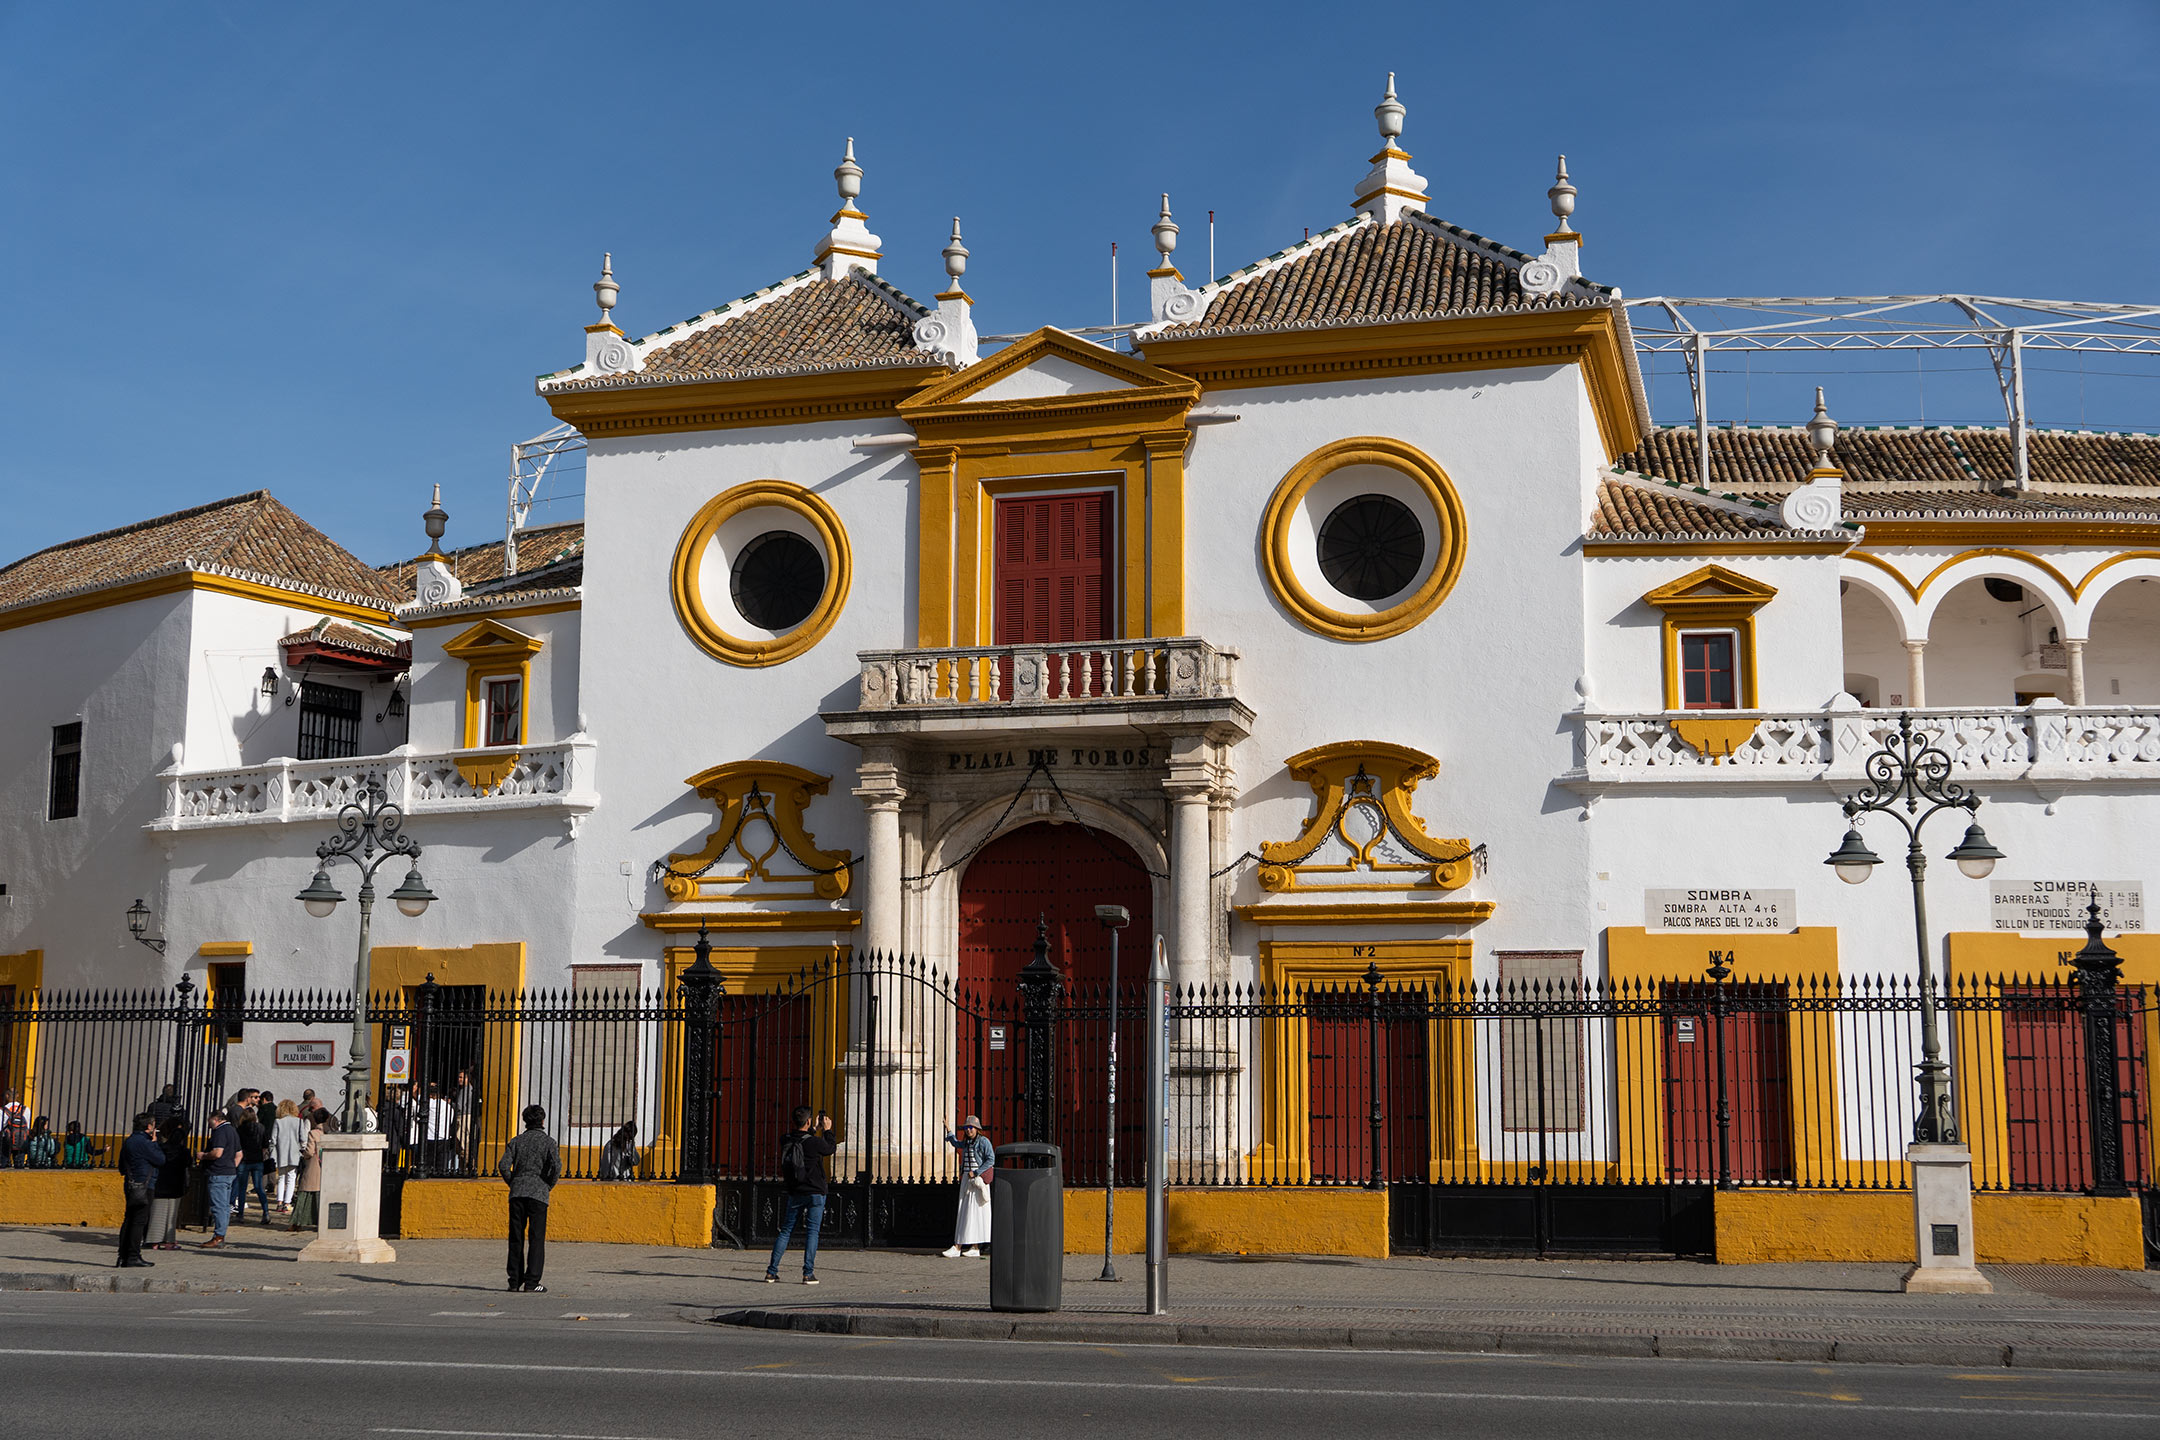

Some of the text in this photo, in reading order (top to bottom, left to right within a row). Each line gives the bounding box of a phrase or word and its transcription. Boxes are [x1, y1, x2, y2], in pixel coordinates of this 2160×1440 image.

[949, 749, 1150, 770] PLAZA DE TOROS
[2033, 881, 2099, 892] SOMBRA
[1687, 890, 1752, 901] SOMBRA
[1994, 894, 2050, 905] BARRERAS
[1664, 904, 1708, 914] SOMBRA
[1718, 904, 1747, 914] ALTA
[1754, 904, 1761, 914] 4
[1771, 904, 1777, 914] 6
[2026, 908, 2071, 918] TENDIDOS
[1663, 916, 1692, 928] PALCOS
[1695, 916, 1722, 928] PARES
[1725, 917, 1741, 928] DEL
[1744, 917, 1754, 928] 12
[1766, 917, 1779, 928] 36
[1995, 919, 2029, 929] SILLON
[2033, 919, 2045, 929] DE
[2106, 919, 2112, 929] 2
[2125, 919, 2141, 930] 156
[1367, 945, 1376, 957] 2
[1724, 950, 1735, 965] 4
[296, 1044, 313, 1052] VISITA
[283, 1053, 326, 1062] PLAZA DE TOROS
